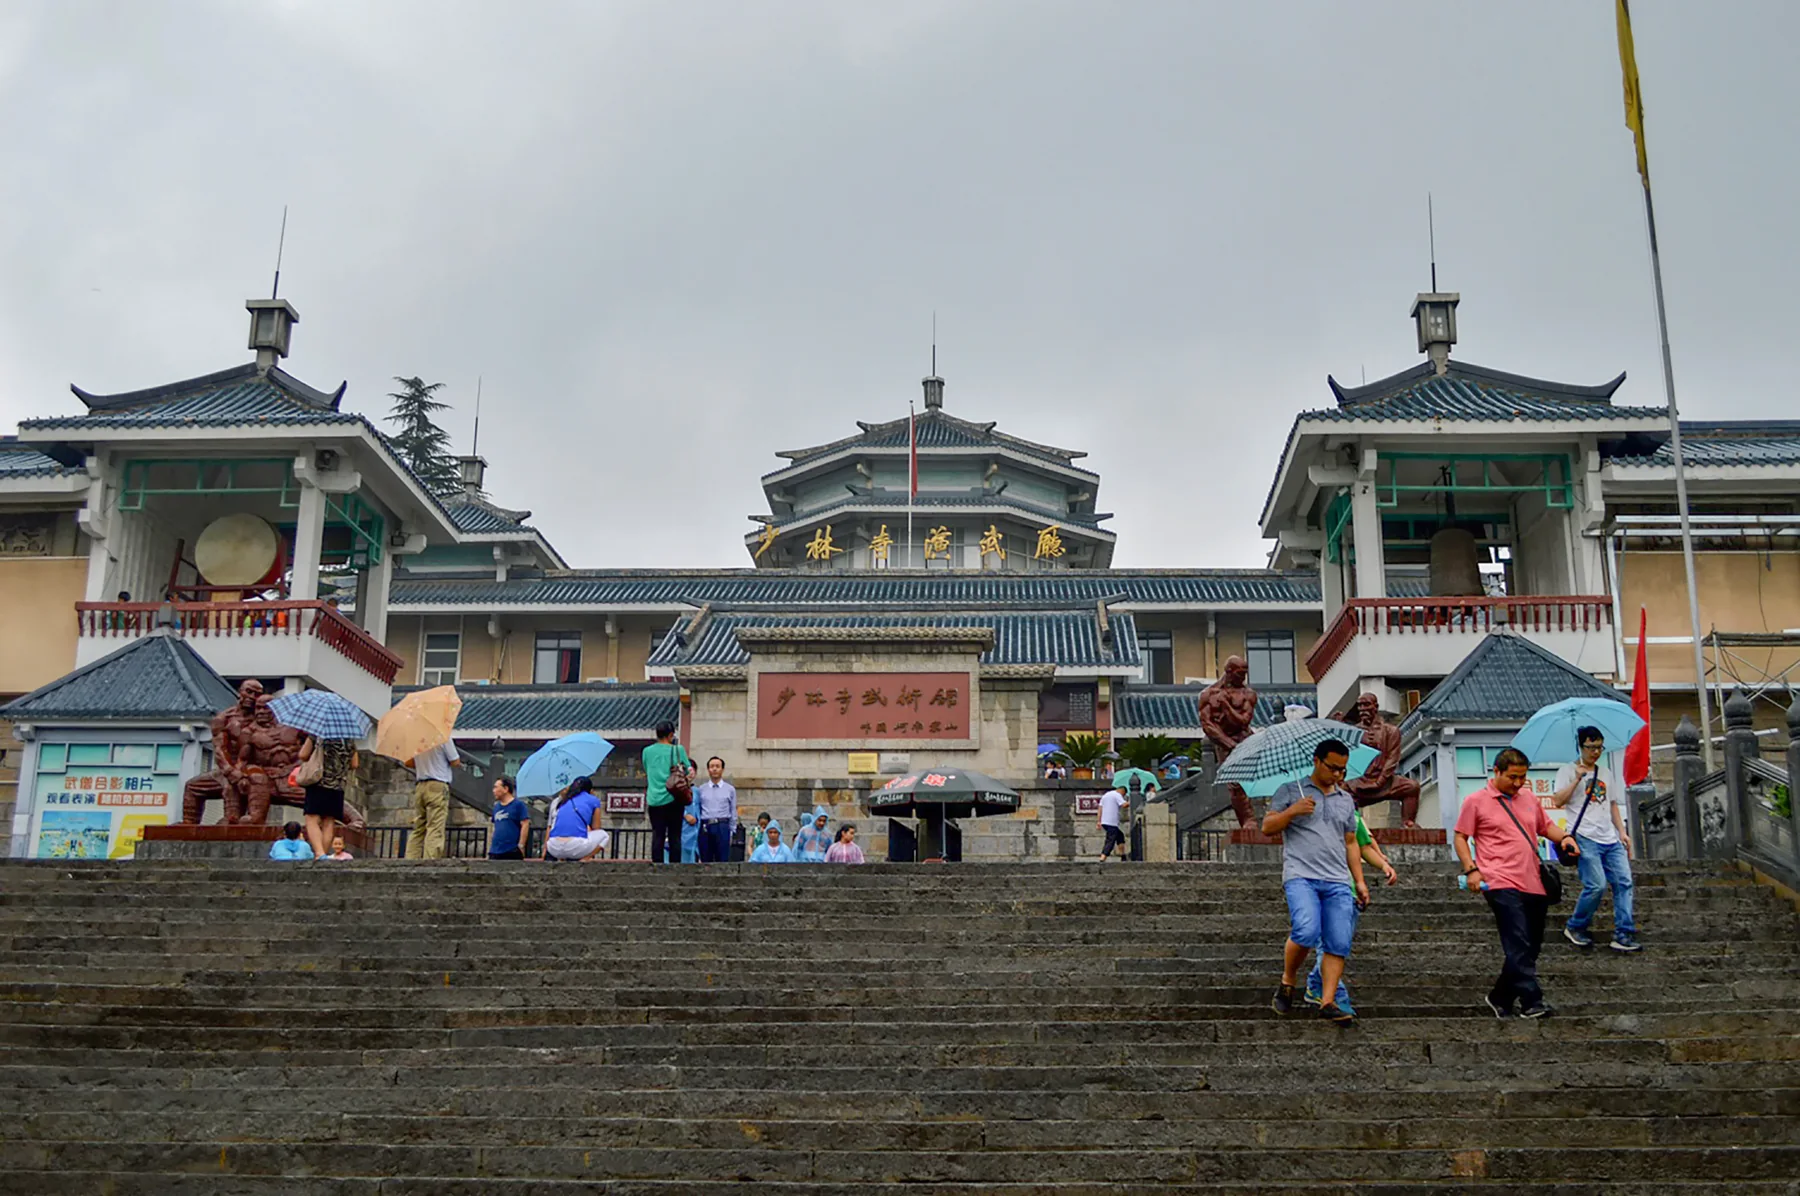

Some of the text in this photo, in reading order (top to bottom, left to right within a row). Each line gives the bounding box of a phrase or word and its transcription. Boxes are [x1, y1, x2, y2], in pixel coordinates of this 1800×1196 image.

[64, 776, 154, 791] 武僧合影相片
[46, 792, 96, 804] 观看表演
